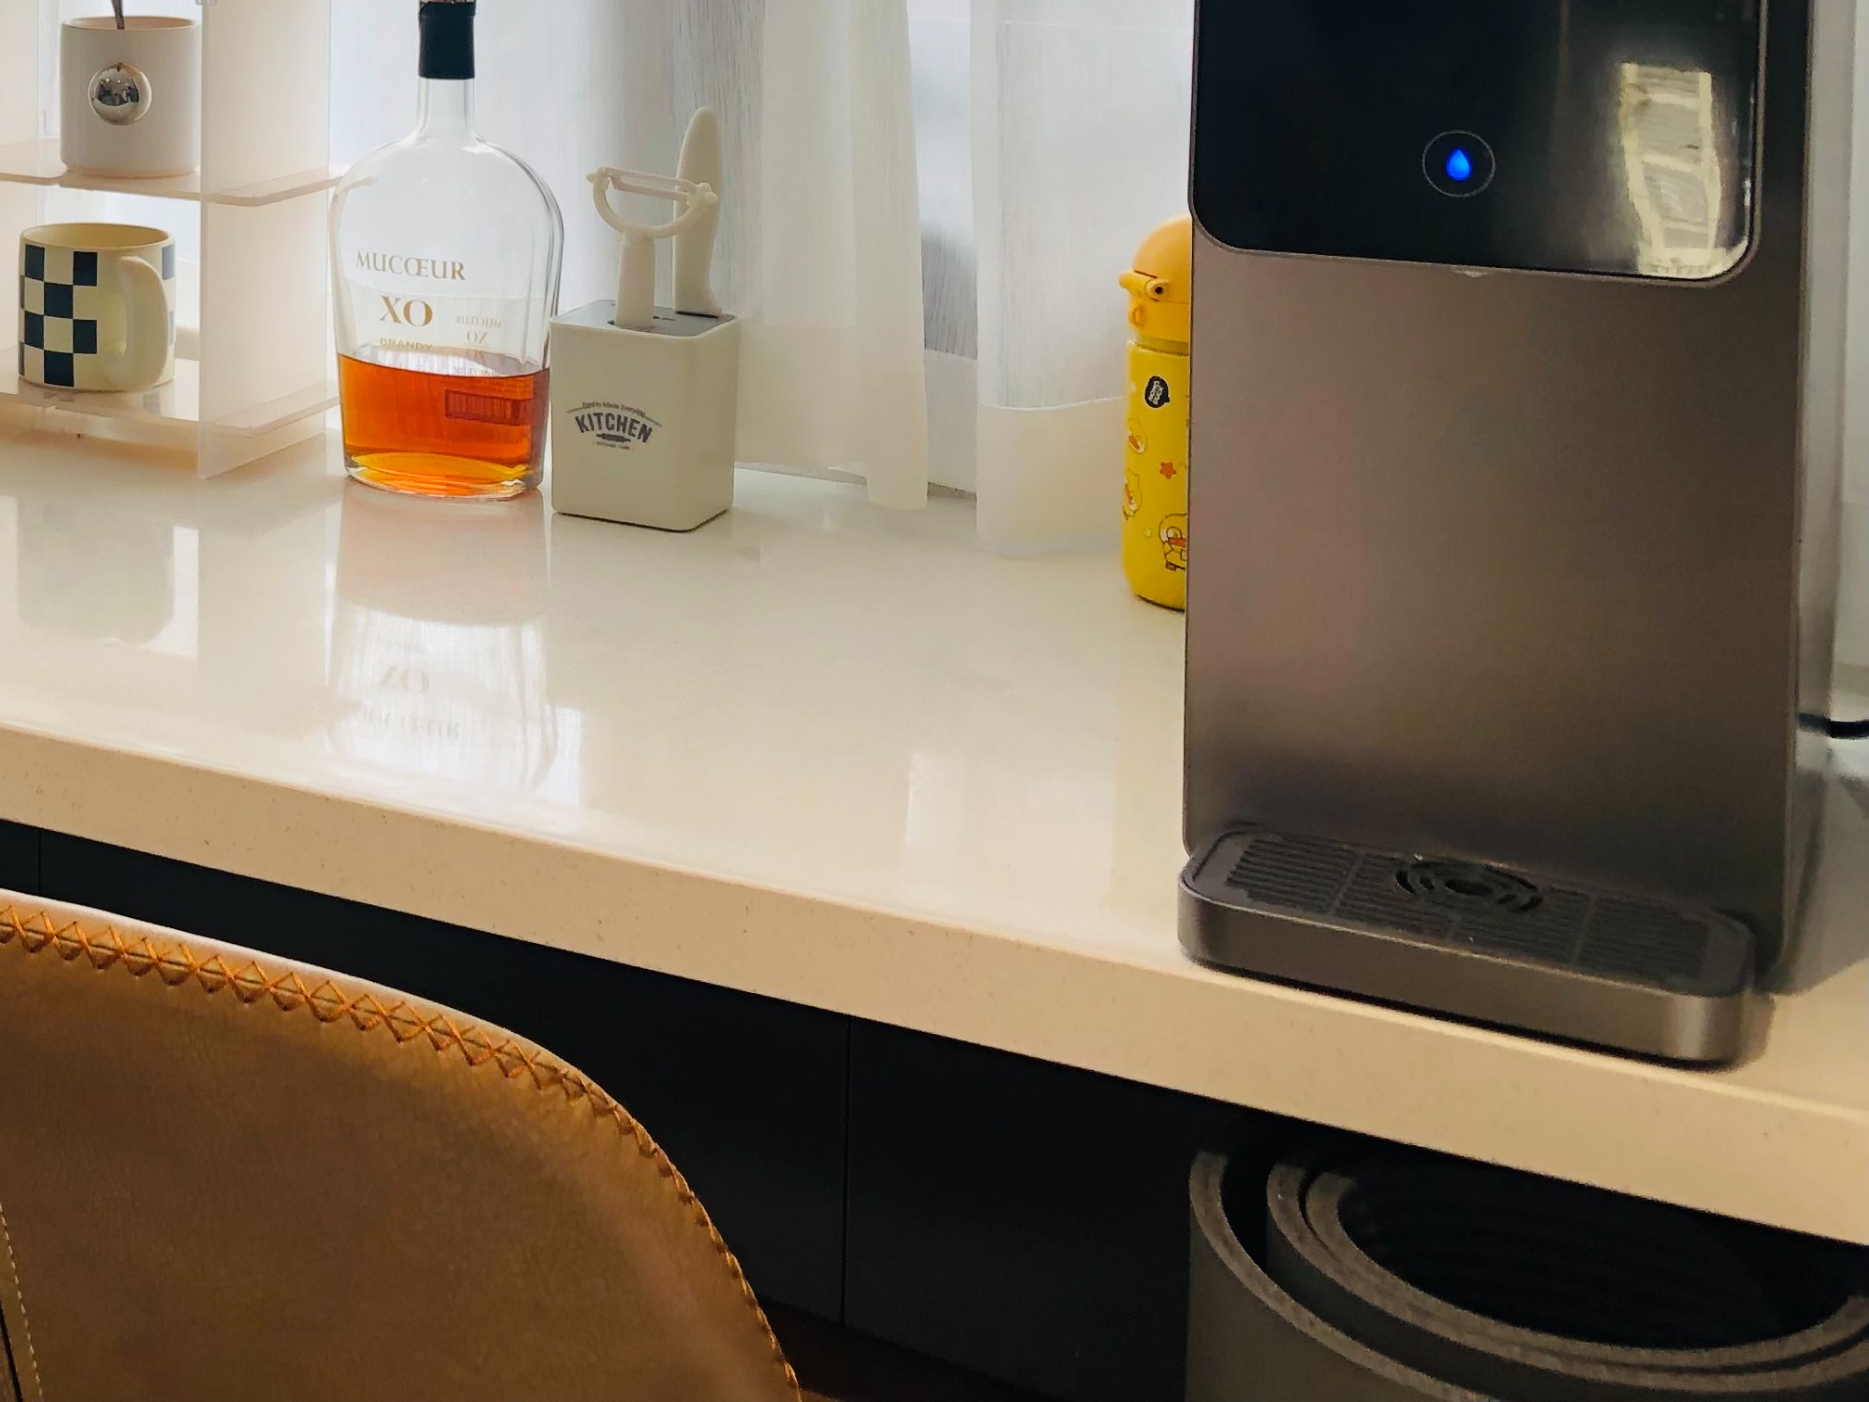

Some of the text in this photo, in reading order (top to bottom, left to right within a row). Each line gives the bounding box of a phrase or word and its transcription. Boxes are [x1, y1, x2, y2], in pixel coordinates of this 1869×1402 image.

[355, 249, 467, 281] MUCŒUR
[379, 295, 433, 327] XO
[379, 337, 433, 352] BRANDY
[574, 412, 653, 444] KITCHEN
